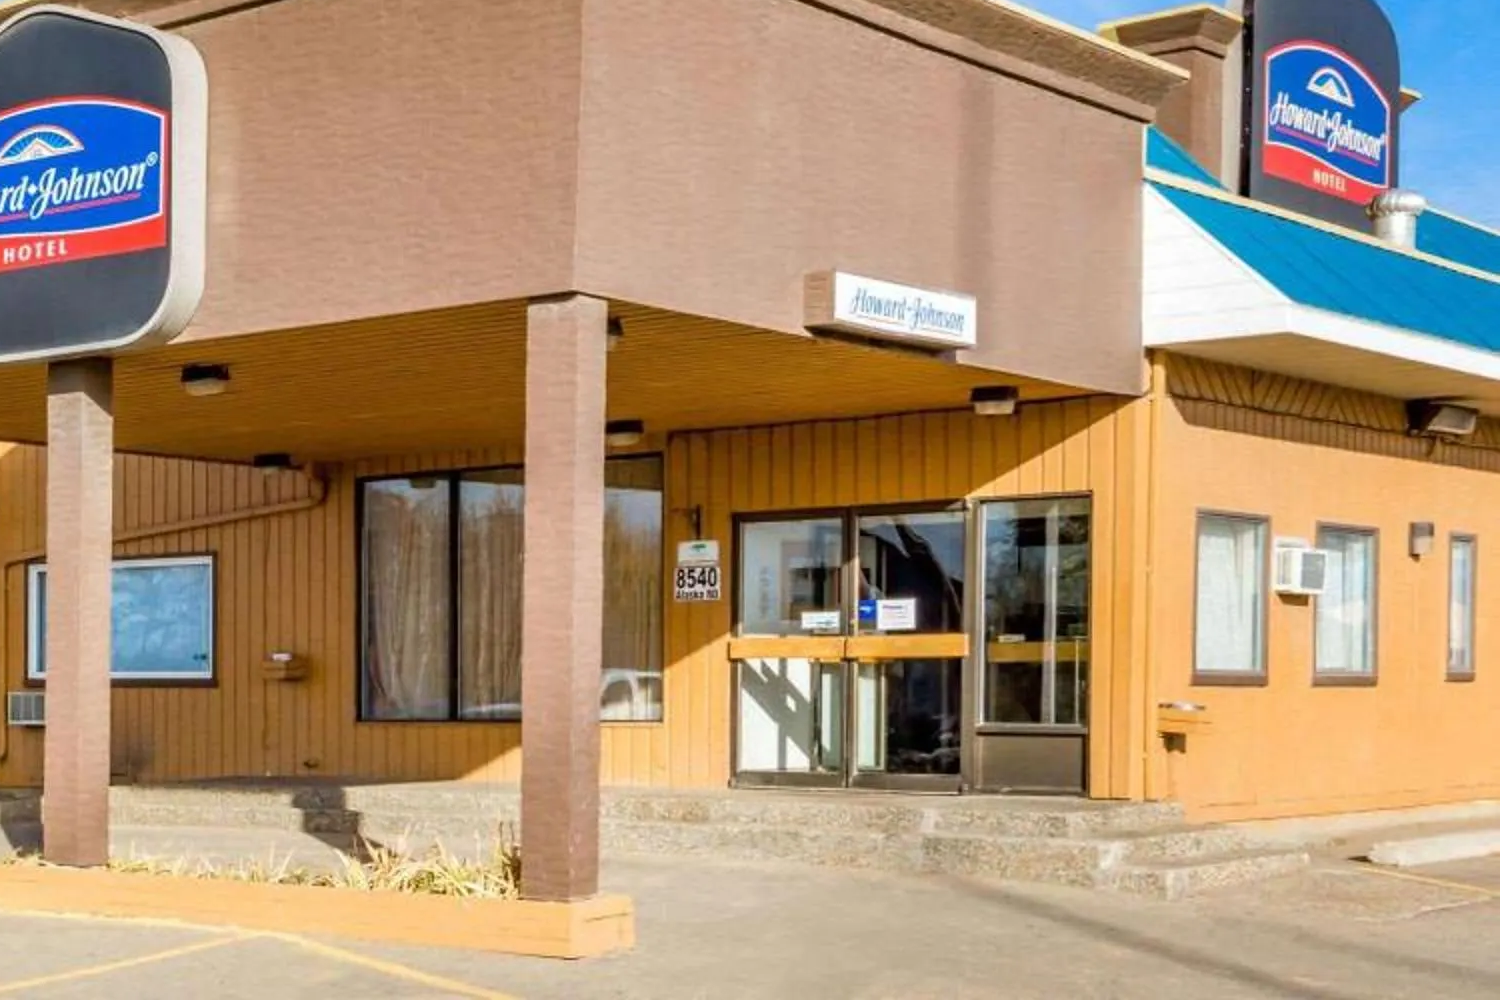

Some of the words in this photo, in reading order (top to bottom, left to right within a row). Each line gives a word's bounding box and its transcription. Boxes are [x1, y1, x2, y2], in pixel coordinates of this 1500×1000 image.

[1313, 170, 1347, 192] HOTEL
[3, 240, 67, 265] HOTEL
[676, 568, 717, 588] 8540
